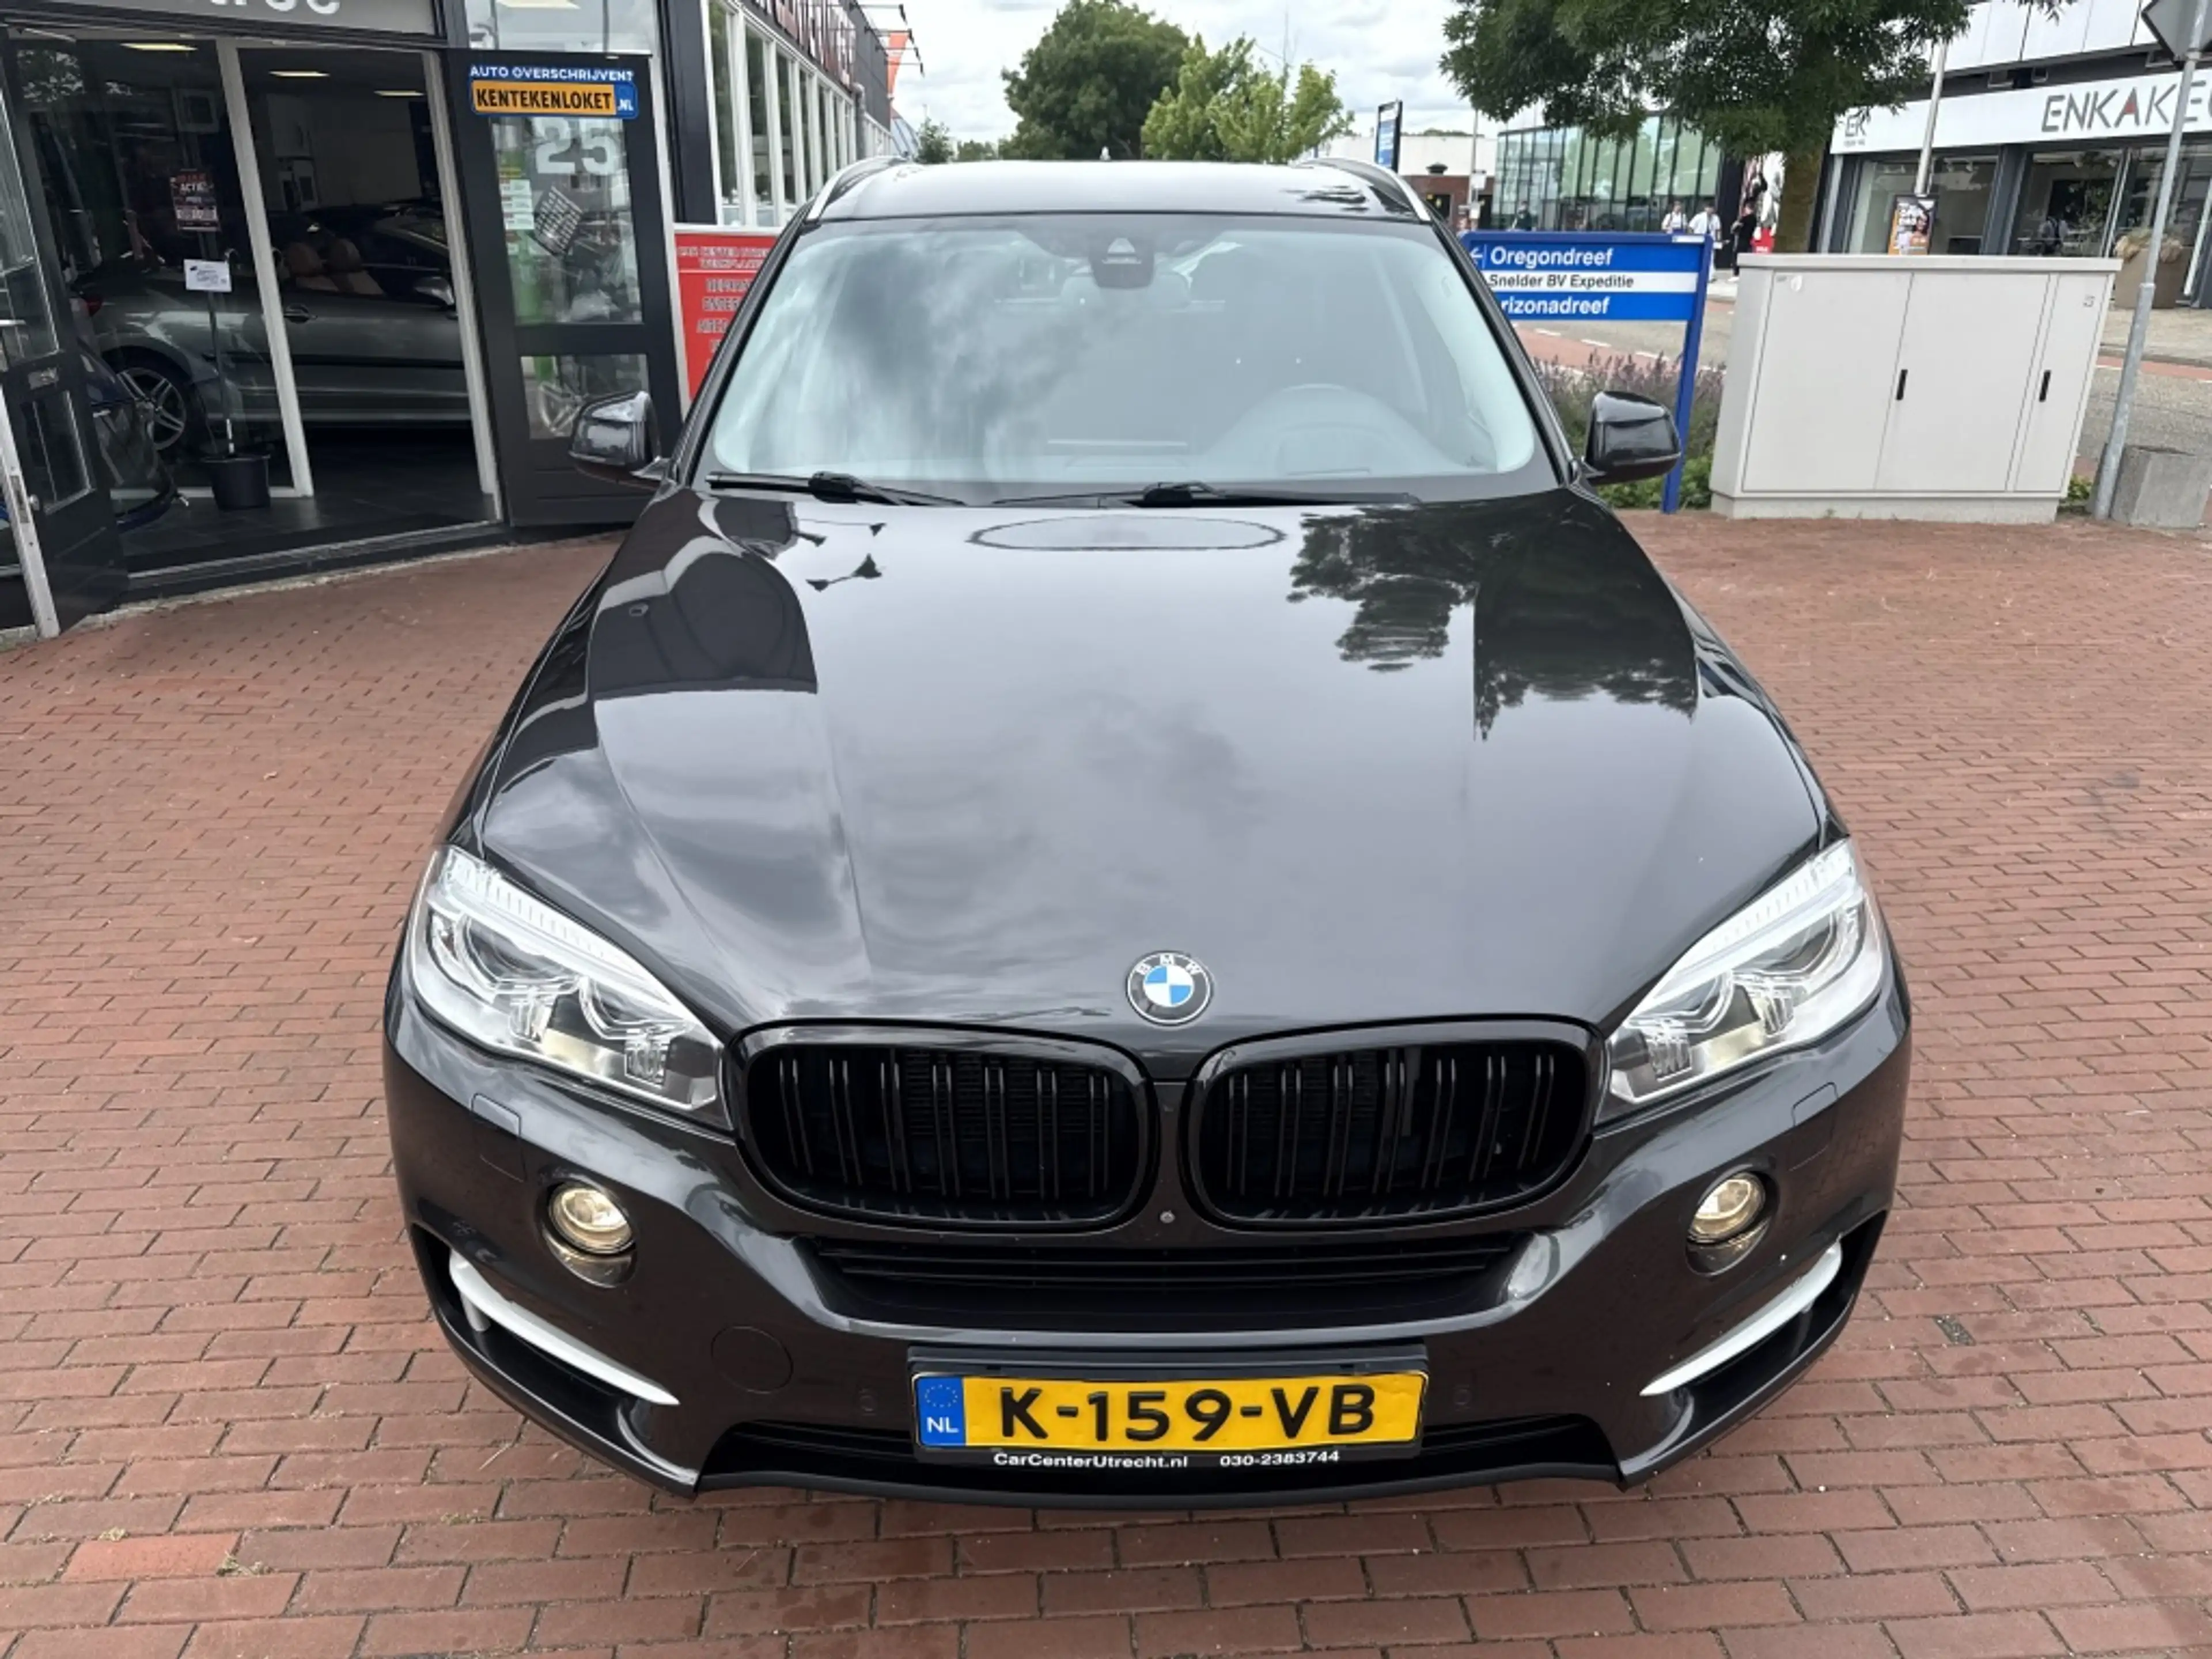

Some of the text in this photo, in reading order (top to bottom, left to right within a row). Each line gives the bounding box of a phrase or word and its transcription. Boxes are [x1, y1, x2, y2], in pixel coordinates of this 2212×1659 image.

[469, 64, 634, 81] AUTO OVERSCHRIJVEN?
[476, 88, 612, 109] KENTEKENLOKET
[2041, 79, 2212, 132] ENKAKE
[532, 117, 618, 176] 25
[1490, 247, 1613, 269] Oregondreef
[1488, 274, 1634, 290] Snelder BV Expeditie
[1501, 296, 1611, 315] rizonadreef
[1135, 953, 1202, 975] BMW
[1000, 1384, 1375, 1442] K-159-VB
[926, 1416, 959, 1433] NL
[993, 1450, 1340, 1468] CarCenterUtrecht.nl 030-2383744
